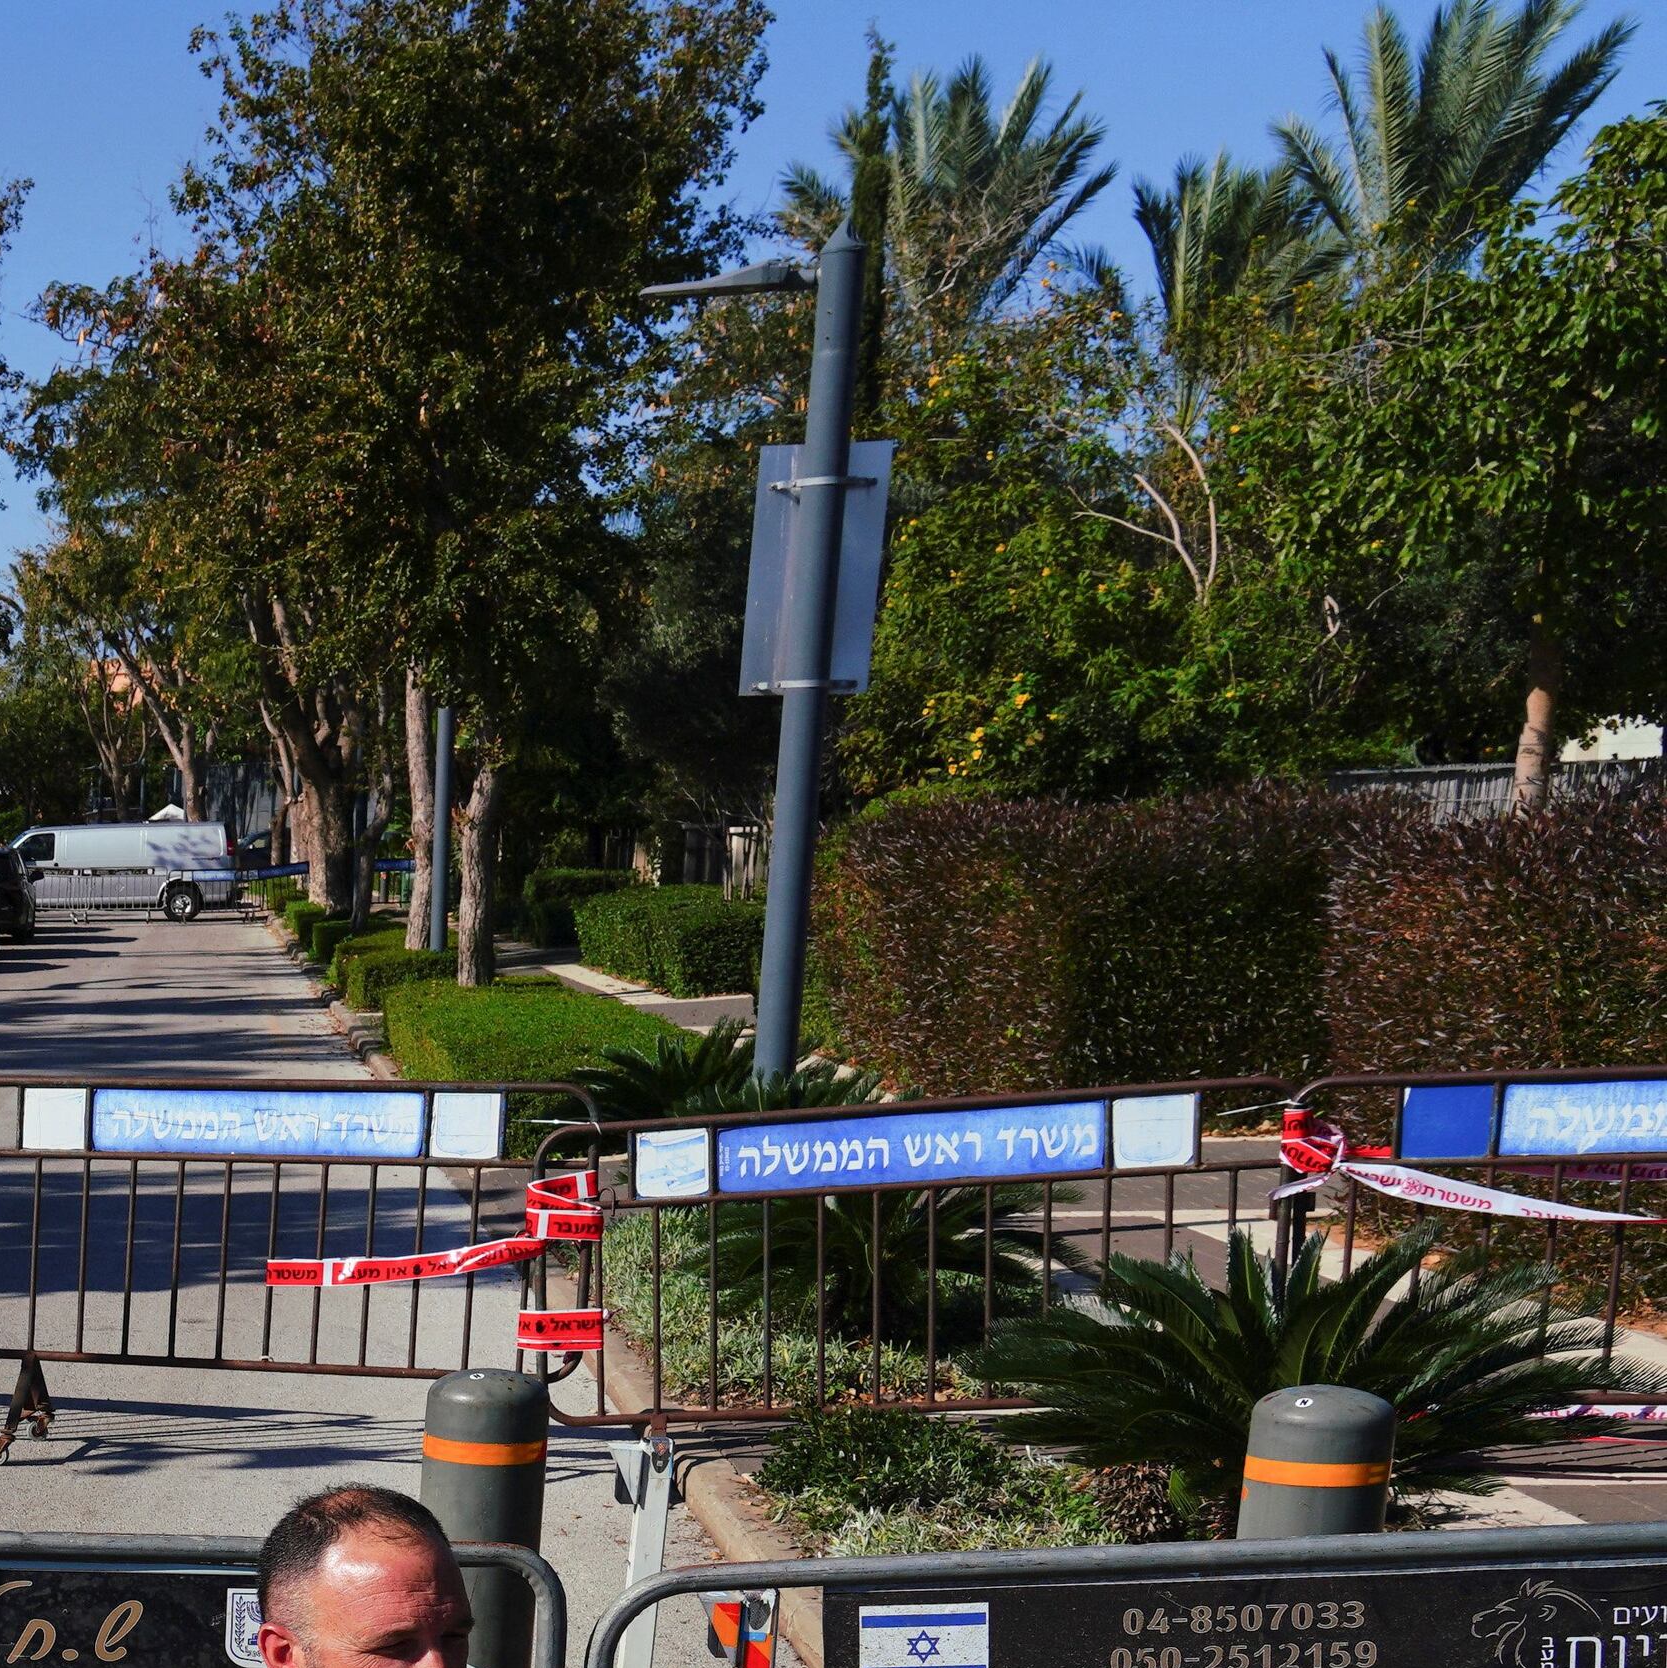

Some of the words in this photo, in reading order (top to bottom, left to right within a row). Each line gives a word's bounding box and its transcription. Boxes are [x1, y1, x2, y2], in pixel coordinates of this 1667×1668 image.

[111, 1104, 242, 1143] הממשלה
[997, 1122, 1098, 1162] משרד
[1525, 1097, 1667, 1148] משלה
[738, 1134, 890, 1179] הממשלה
[903, 1129, 983, 1168] ראש
[1122, 1599, 1366, 1636] 04-8507033
[1613, 1605, 1667, 1627] ועים
